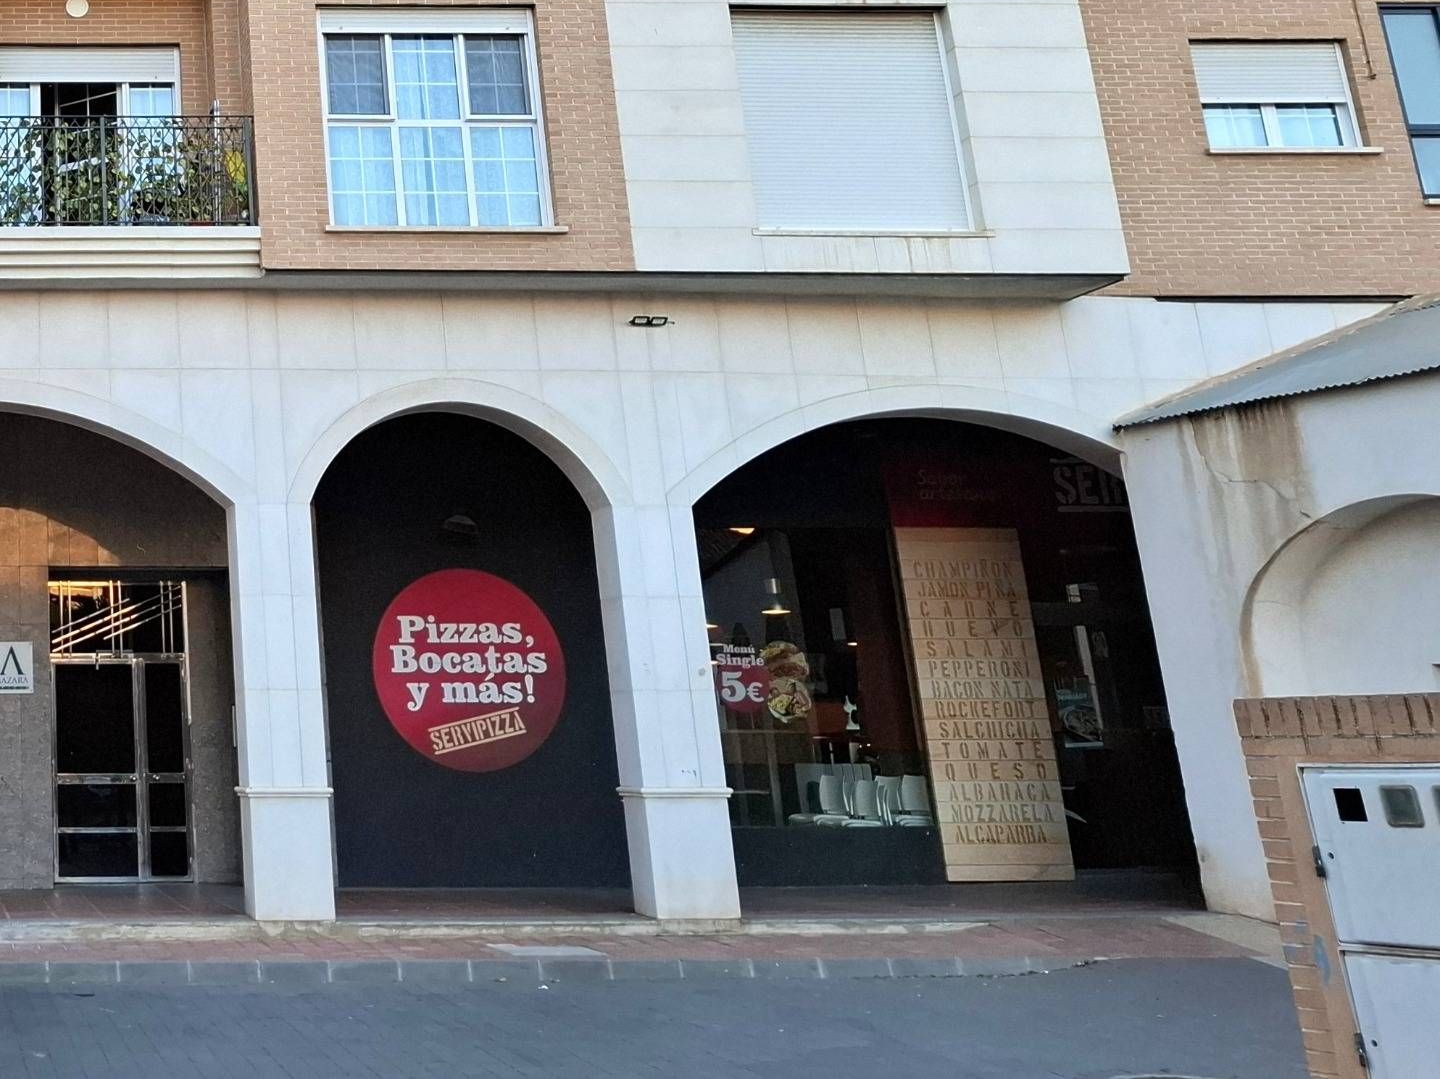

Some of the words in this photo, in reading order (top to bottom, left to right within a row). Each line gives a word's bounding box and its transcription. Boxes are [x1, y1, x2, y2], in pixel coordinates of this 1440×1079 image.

[918, 581, 969, 598] JAMON
[397, 614, 534, 647] Pizzas,
[923, 619, 1023, 638] HUEVO
[723, 644, 755, 653] Menú
[927, 640, 1028, 658] SALAMI
[389, 644, 548, 674] Bocatas
[716, 653, 765, 669] Single
[928, 660, 1031, 678] PEPPERONI
[406, 682, 430, 711] y
[441, 671, 536, 704] más!
[721, 671, 765, 703] 5€
[931, 680, 984, 699] BACON
[991, 680, 1034, 699] NATA
[430, 710, 526, 751] SERVIPIZZA
[939, 721, 1040, 739] SALCHICHA
[941, 741, 1044, 760] TOMATE
[945, 762, 1047, 781] QUESO
[950, 783, 1051, 802] ALBAHACA
[951, 804, 1056, 823] MOZZARELA
